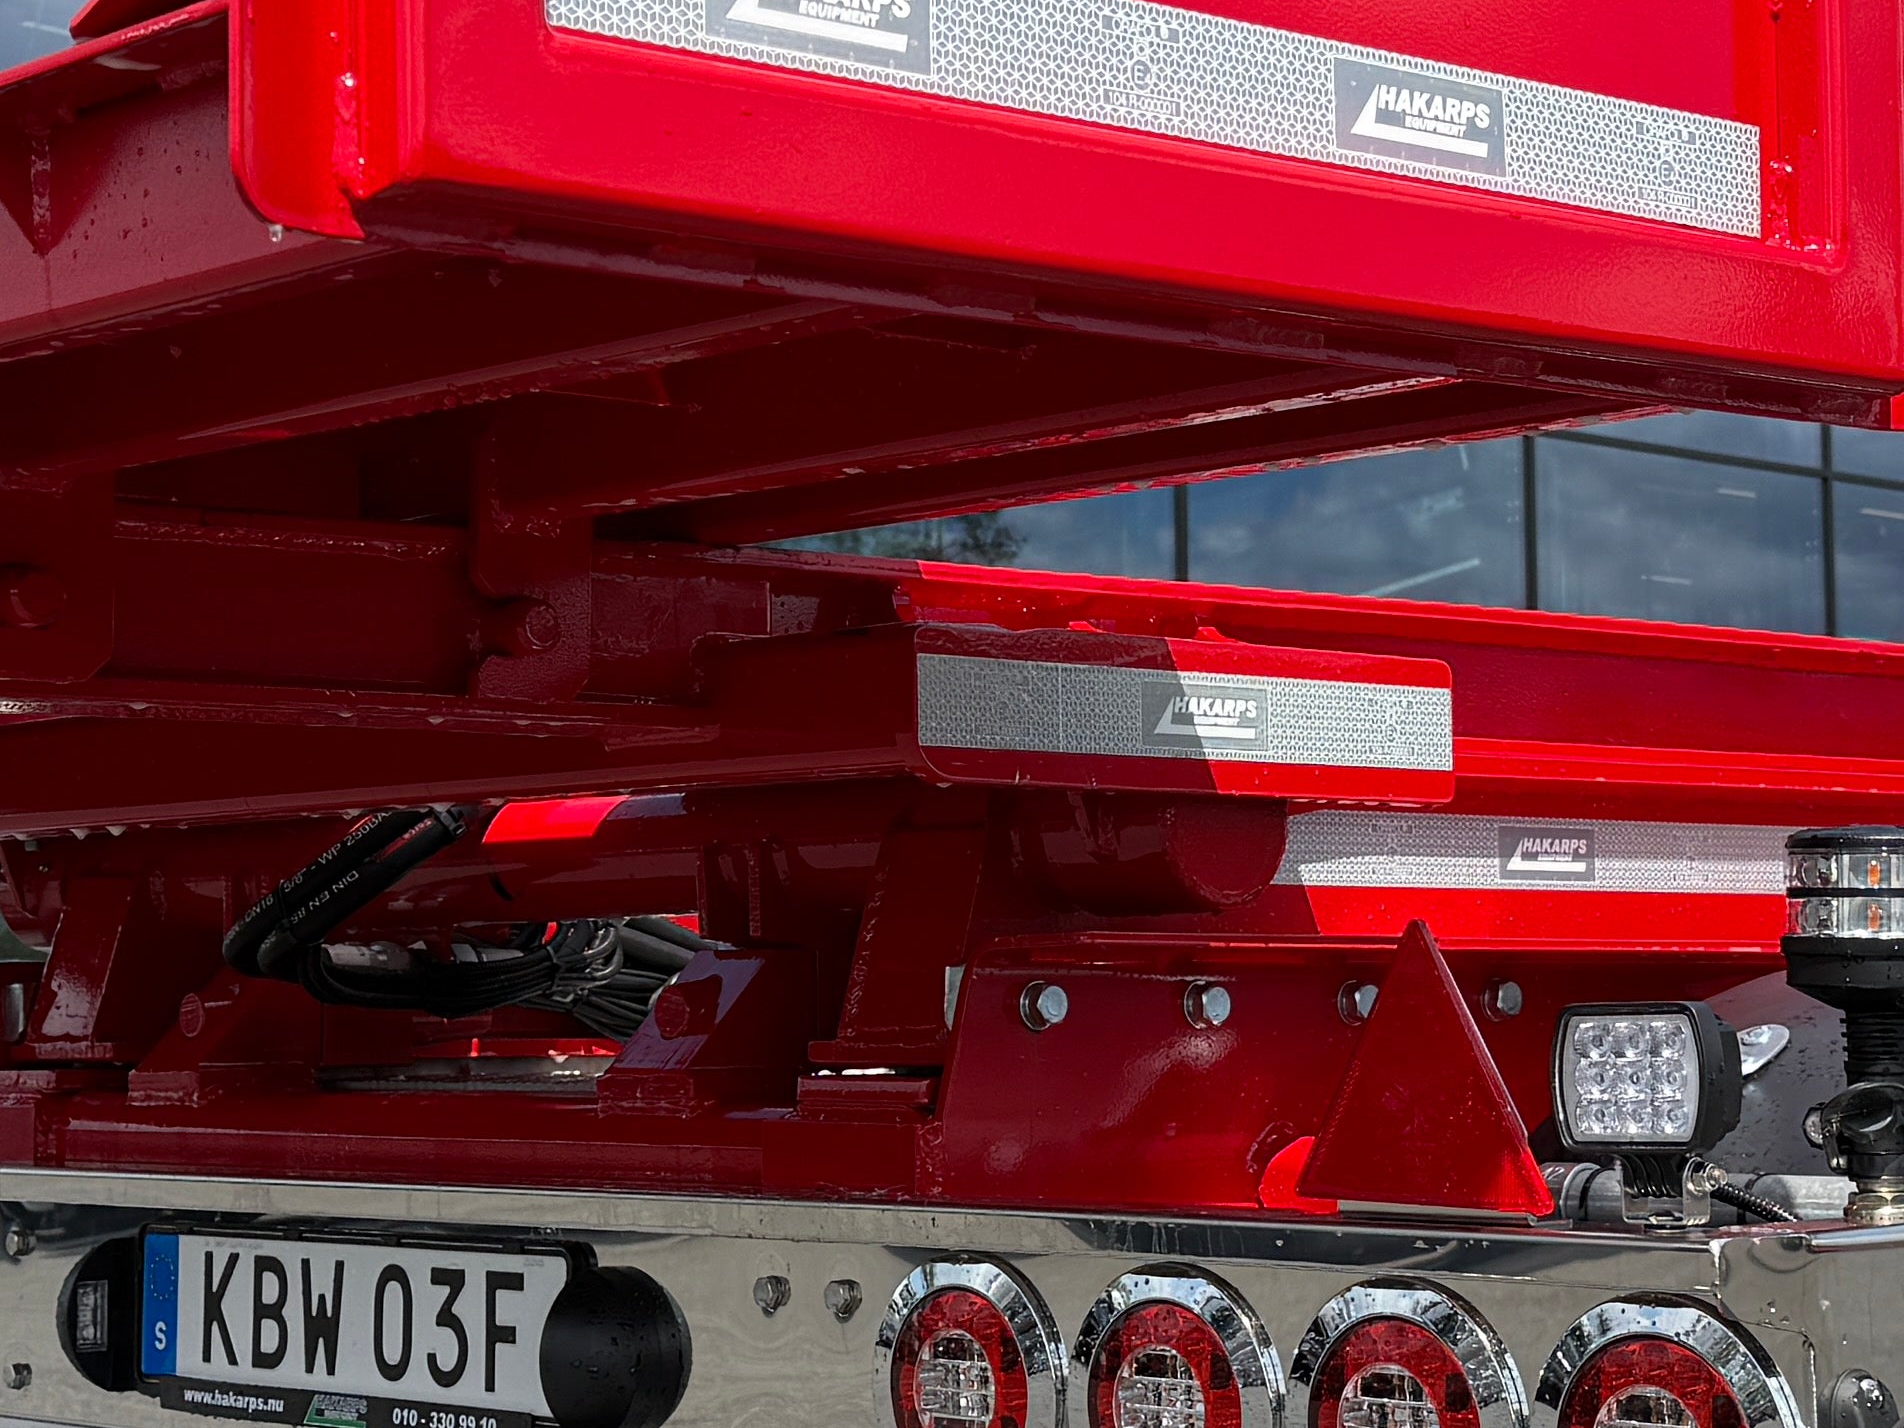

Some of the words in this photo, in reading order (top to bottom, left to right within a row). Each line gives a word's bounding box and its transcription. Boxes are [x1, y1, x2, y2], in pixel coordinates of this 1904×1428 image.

[798, 0, 880, 28] EQUIPMENT
[1378, 84, 1491, 129] HAKARPS
[1405, 115, 1466, 138] EQUIPMENT
[1174, 696, 1257, 719] HAKARPS
[318, 843, 341, 864] WP
[1523, 837, 1587, 854] HAKARPS
[202, 1250, 345, 1377] KBW
[372, 1263, 526, 1393] 03F
[154, 1320, 167, 1351] S
[184, 1387, 284, 1413] www.hakarps.nu
[392, 1407, 417, 1427] 010
